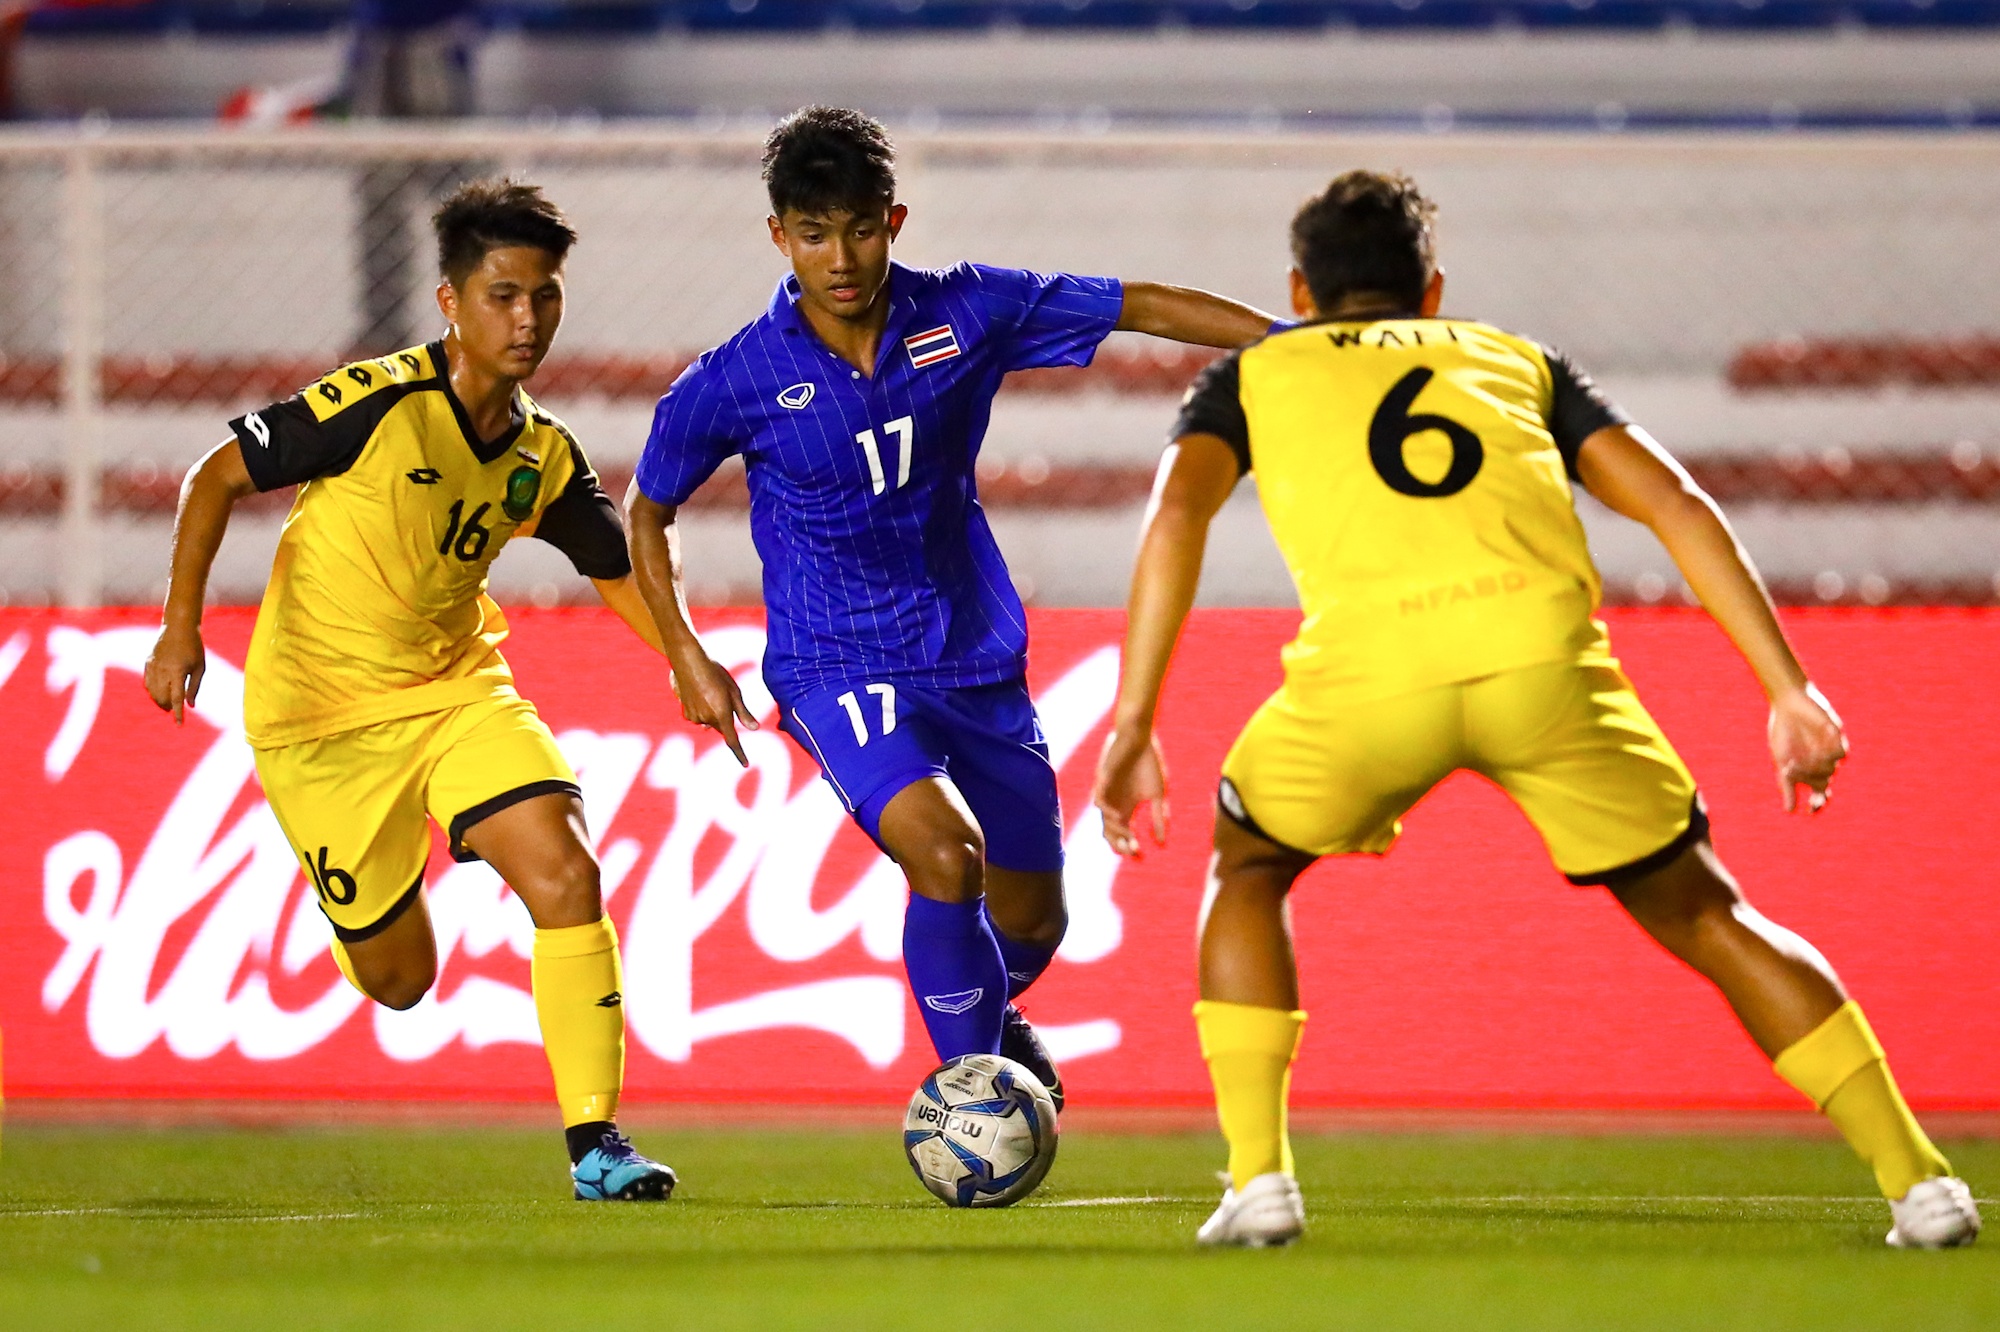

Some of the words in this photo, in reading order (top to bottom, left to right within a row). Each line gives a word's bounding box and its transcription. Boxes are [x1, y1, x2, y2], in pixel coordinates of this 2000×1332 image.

[855, 415, 913, 496] 17
[1368, 365, 1484, 498] 6
[440, 499, 491, 561] 16
[837, 683, 897, 748] 17
[304, 846, 357, 905] 16
[918, 1104, 983, 1138] molten
